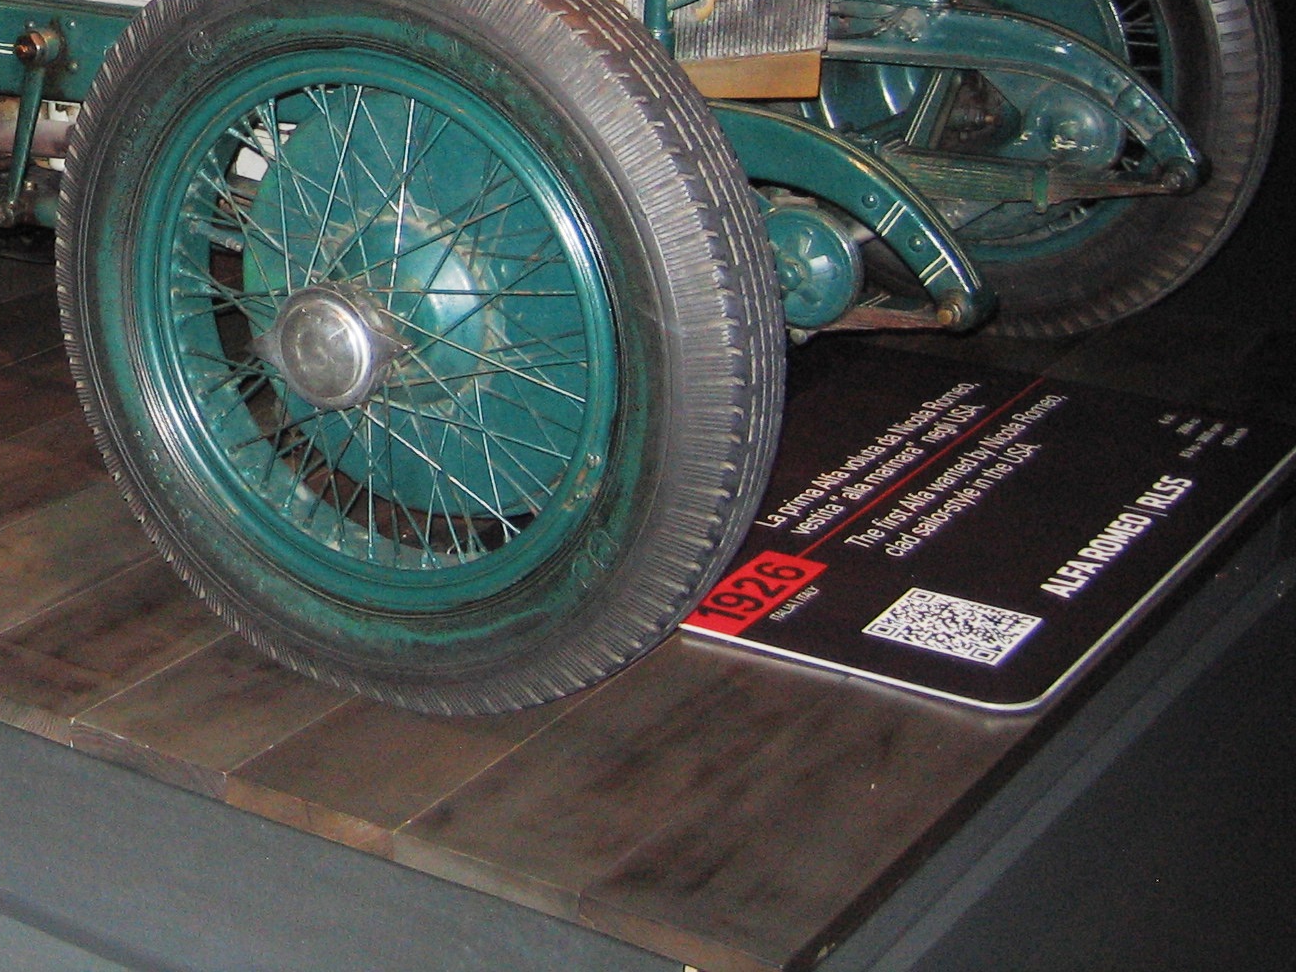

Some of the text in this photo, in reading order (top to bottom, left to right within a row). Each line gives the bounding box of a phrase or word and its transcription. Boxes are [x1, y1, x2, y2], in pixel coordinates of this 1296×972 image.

[754, 382, 981, 528] La prima Alfa voluta da Nicola Romeo,
[790, 509, 845, 535] vestita
[921, 420, 958, 444] negli
[945, 403, 986, 425] USA.
[844, 394, 1069, 548] The first Alfa wanted by Nicola Romeo,
[885, 442, 1042, 557] clad sailor-style in the USA.
[697, 561, 806, 621] 1926
[1040, 475, 1193, 599] ALFA ROMEO RLSS
